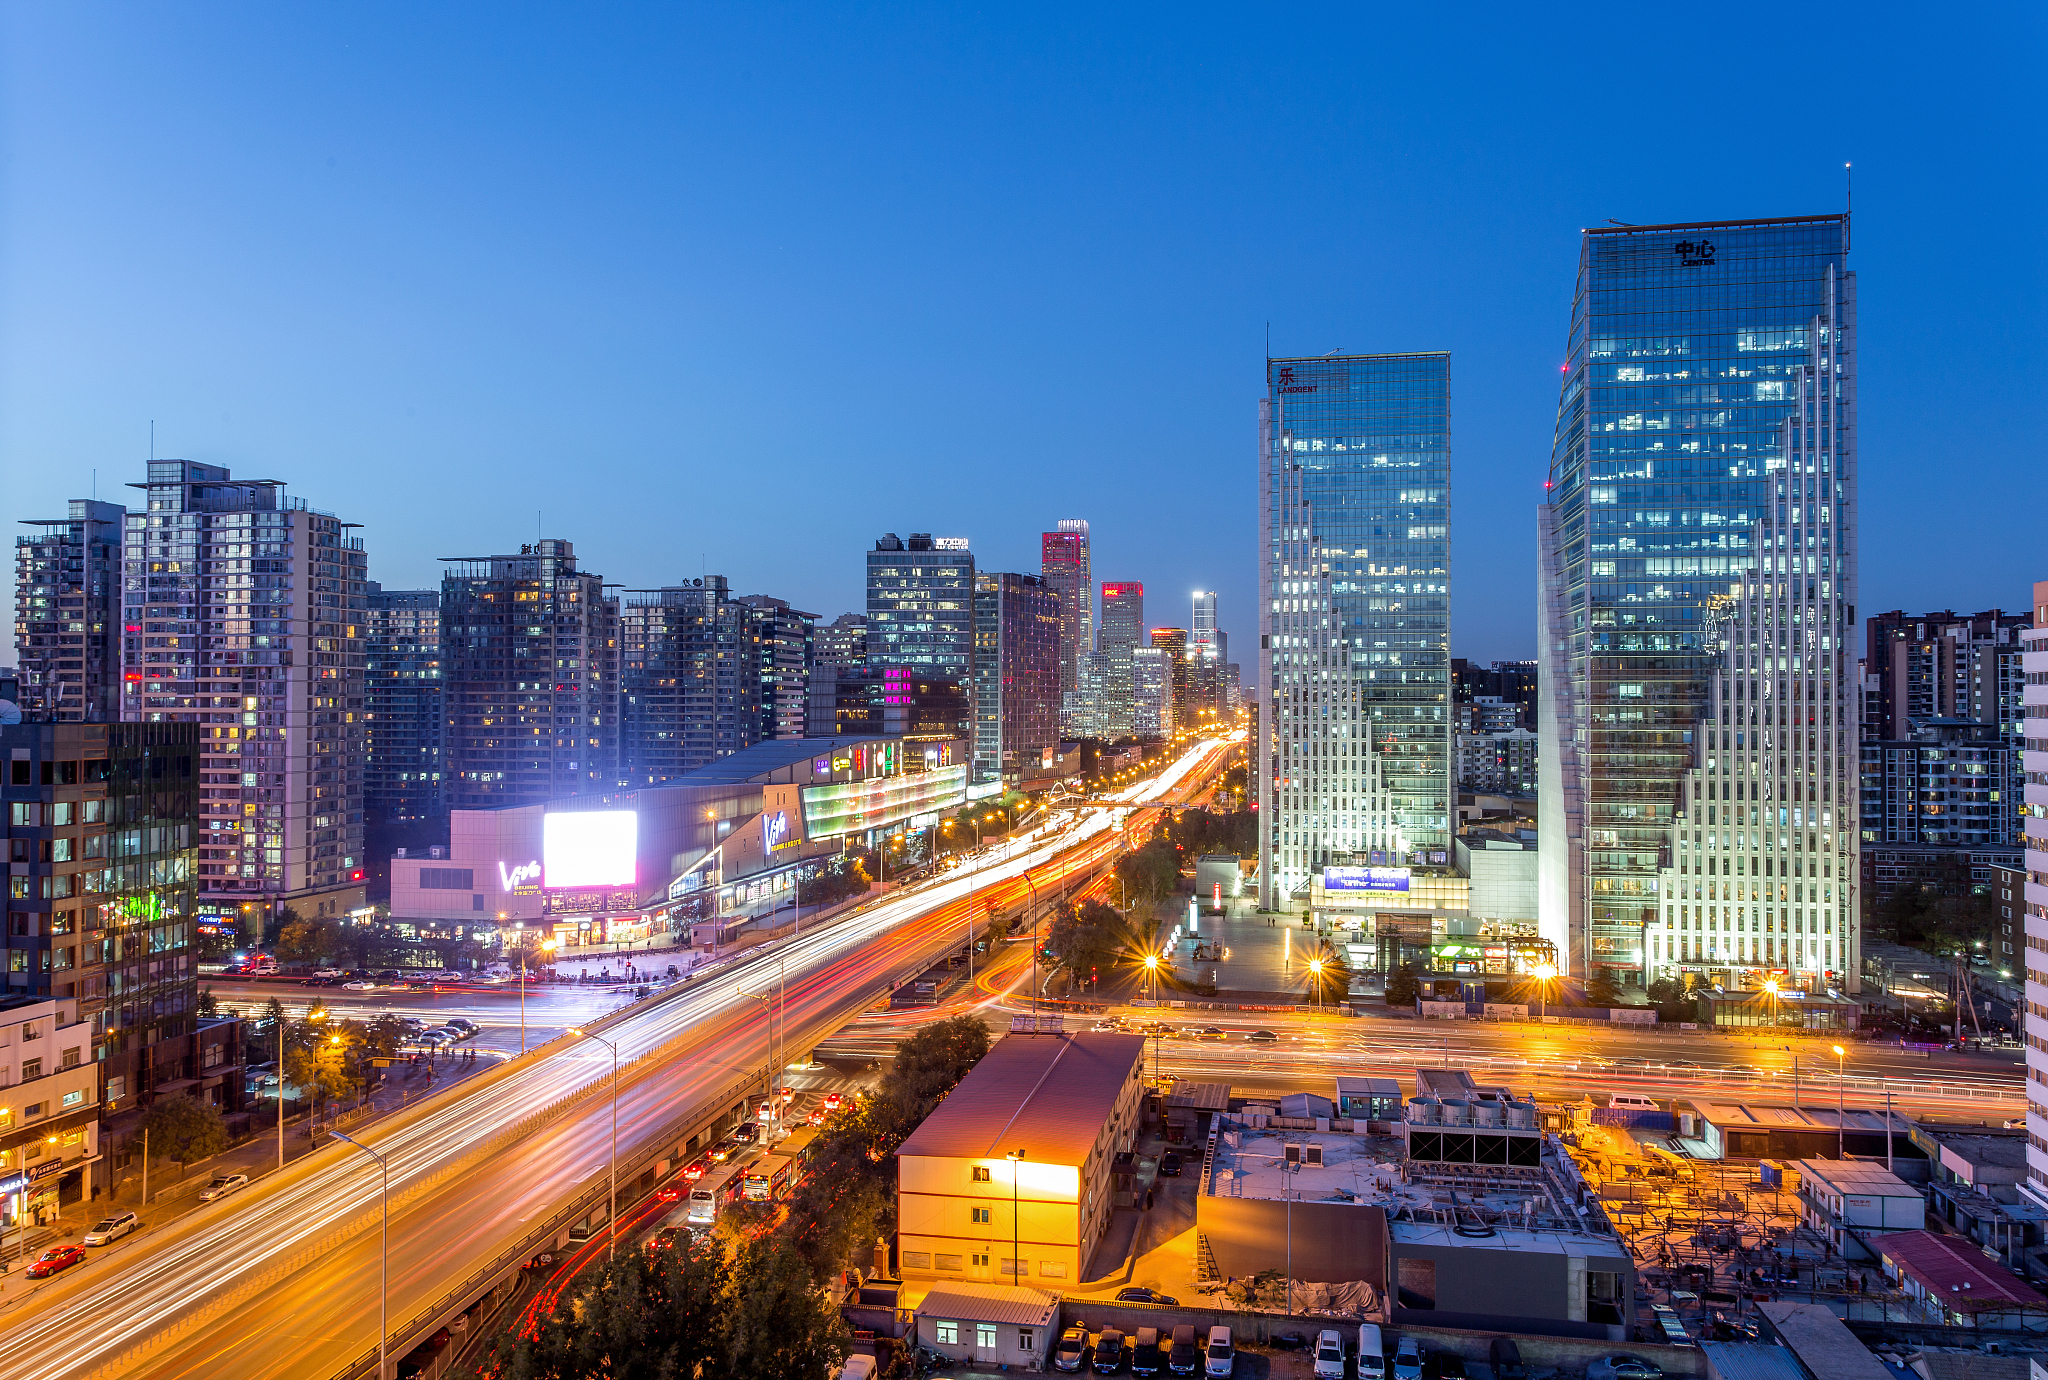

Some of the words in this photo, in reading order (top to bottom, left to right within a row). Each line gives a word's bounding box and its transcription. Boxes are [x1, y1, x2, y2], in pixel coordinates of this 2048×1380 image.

[1675, 239, 1716, 259] 中心
[1278, 367, 1295, 385] 乐
[1277, 386, 1317, 394] LANDGENT
